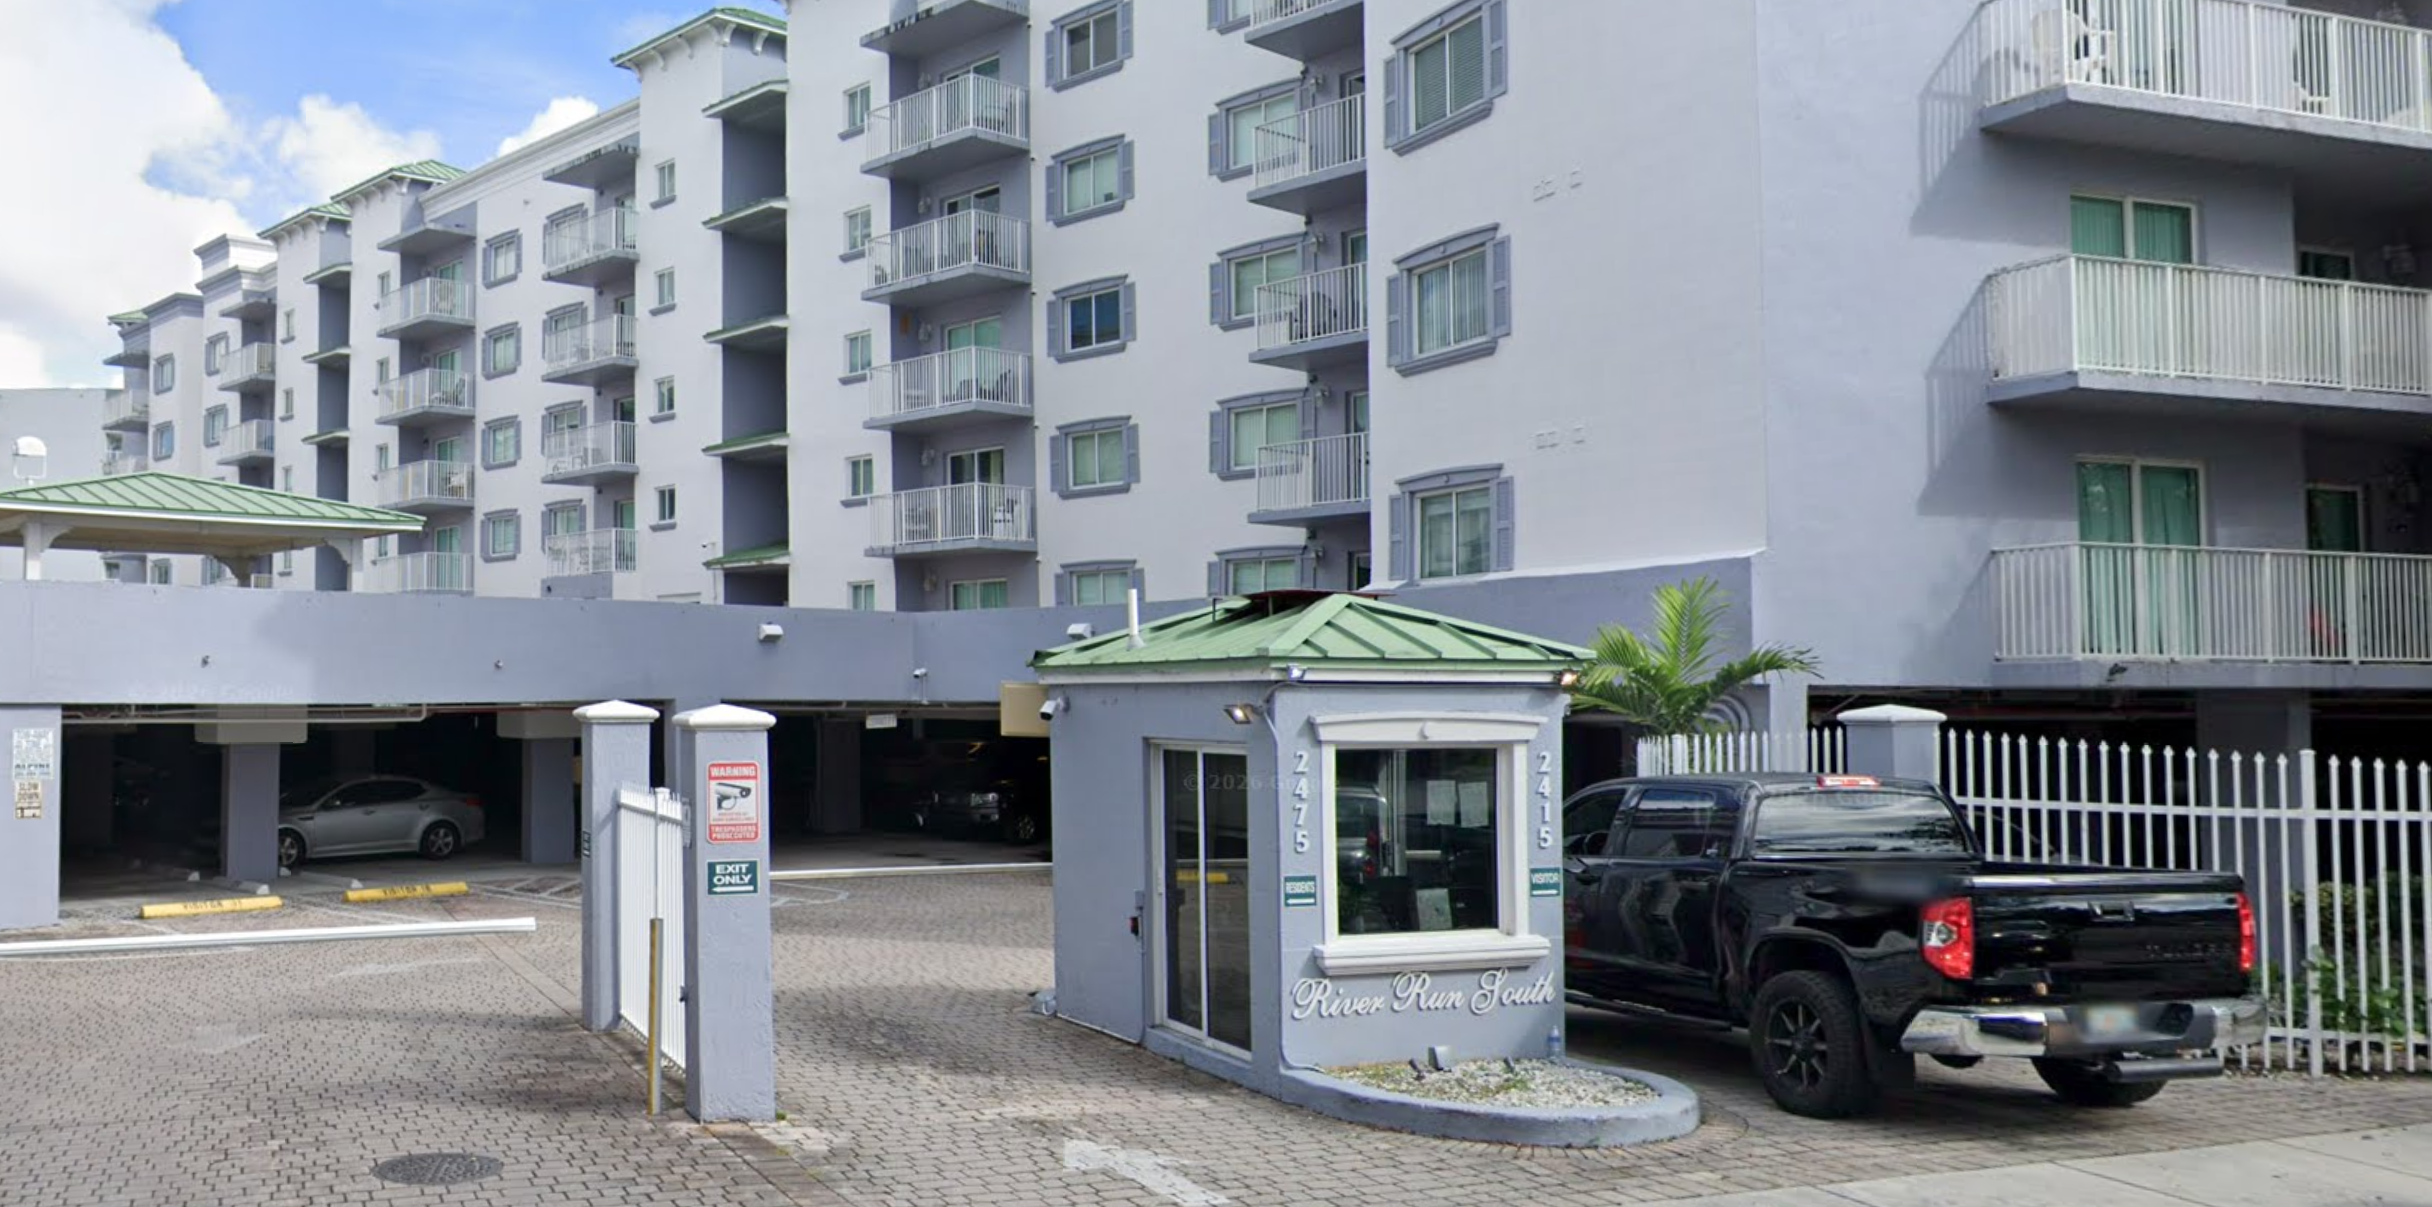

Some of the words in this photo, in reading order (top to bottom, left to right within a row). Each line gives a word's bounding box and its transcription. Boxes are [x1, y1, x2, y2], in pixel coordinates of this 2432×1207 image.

[710, 765, 756, 777] WARNING
[1293, 750, 1310, 854] 2475
[1536, 751, 1553, 850] 2415
[715, 863, 750, 874] EXIT
[713, 874, 752, 885] ONLY
[1531, 872, 1560, 884] VISITOR
[1285, 881, 1315, 893] RESIDENTS
[1292, 977, 1386, 1020] River
[1391, 970, 1464, 1014] Run
[1470, 968, 1556, 1016] South
